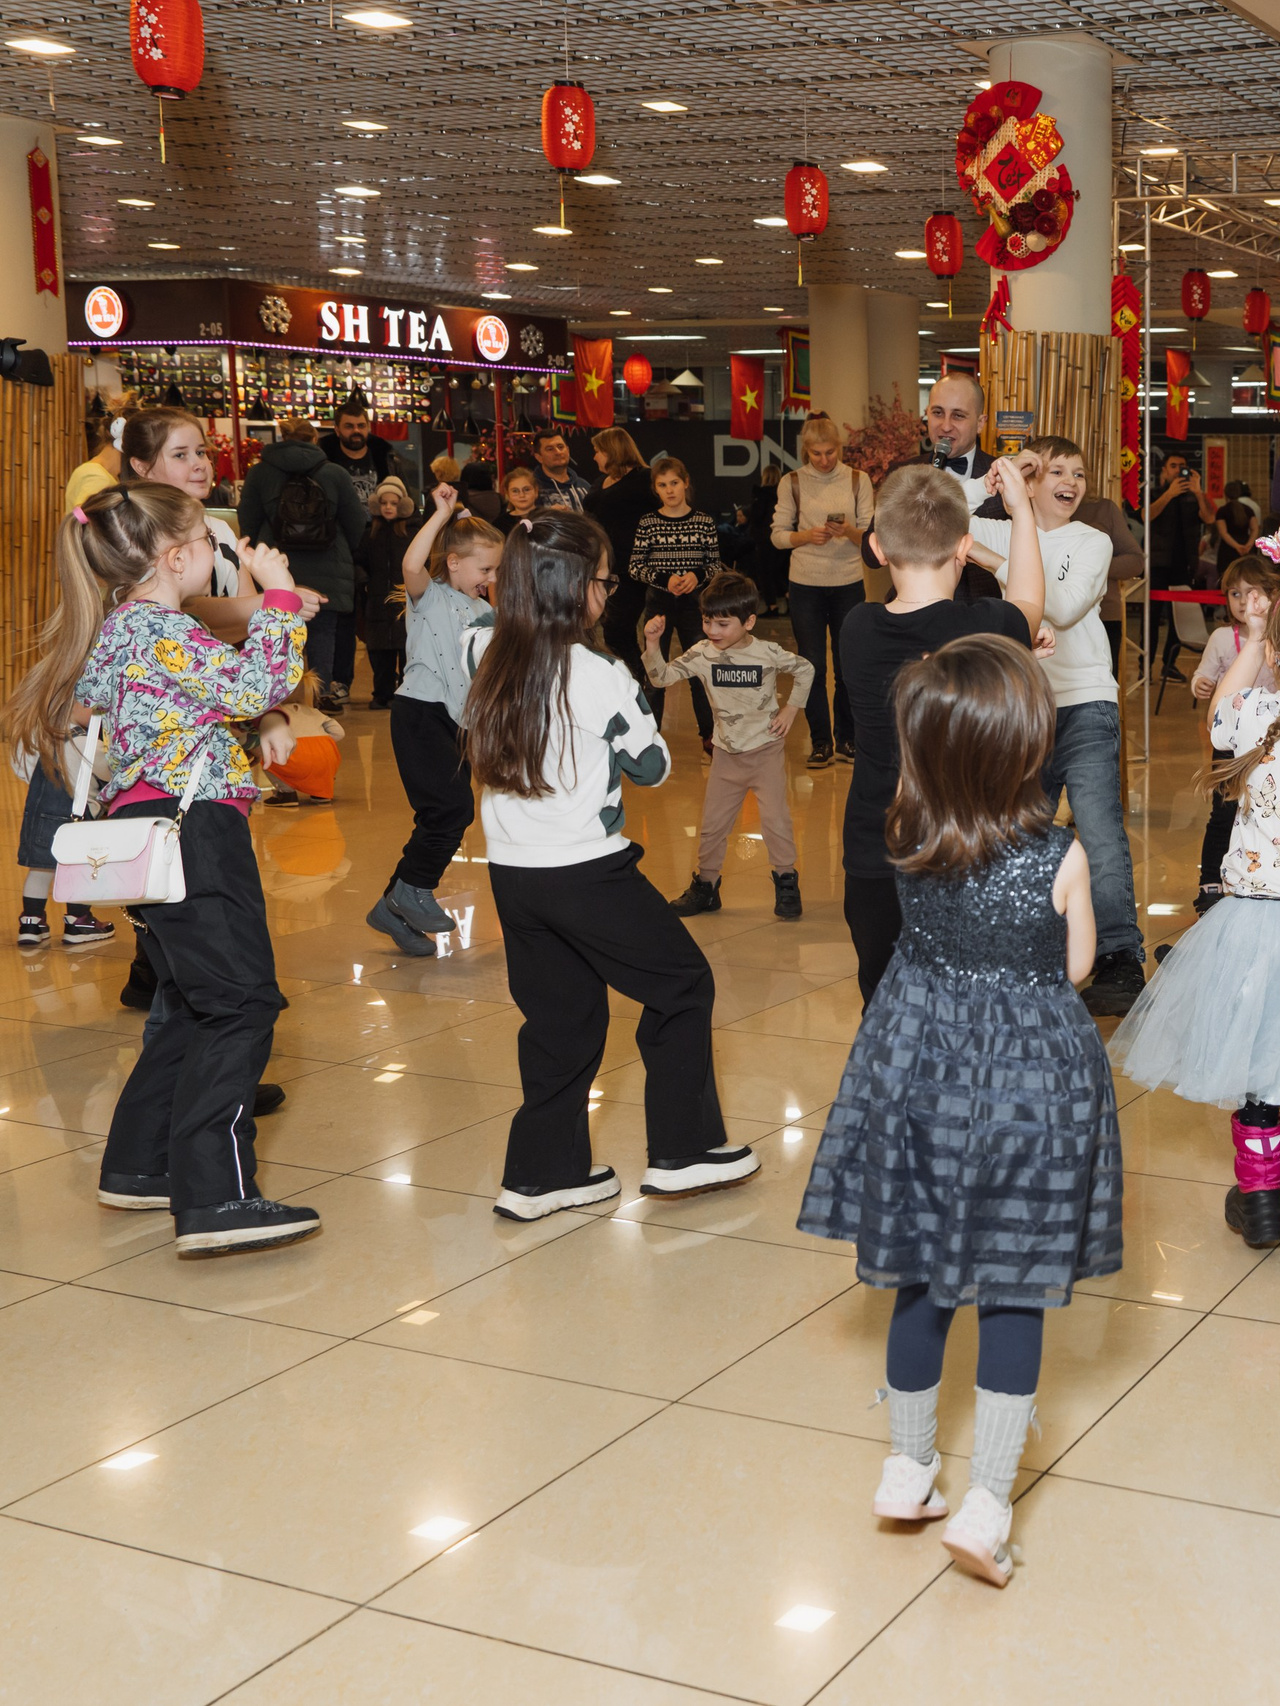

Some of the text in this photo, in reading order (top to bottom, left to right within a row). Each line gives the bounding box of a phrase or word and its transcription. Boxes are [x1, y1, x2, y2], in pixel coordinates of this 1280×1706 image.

[199, 322, 223, 337] 2-05
[320, 301, 453, 353] SH TEA
[547, 354, 566, 367] 2-05
